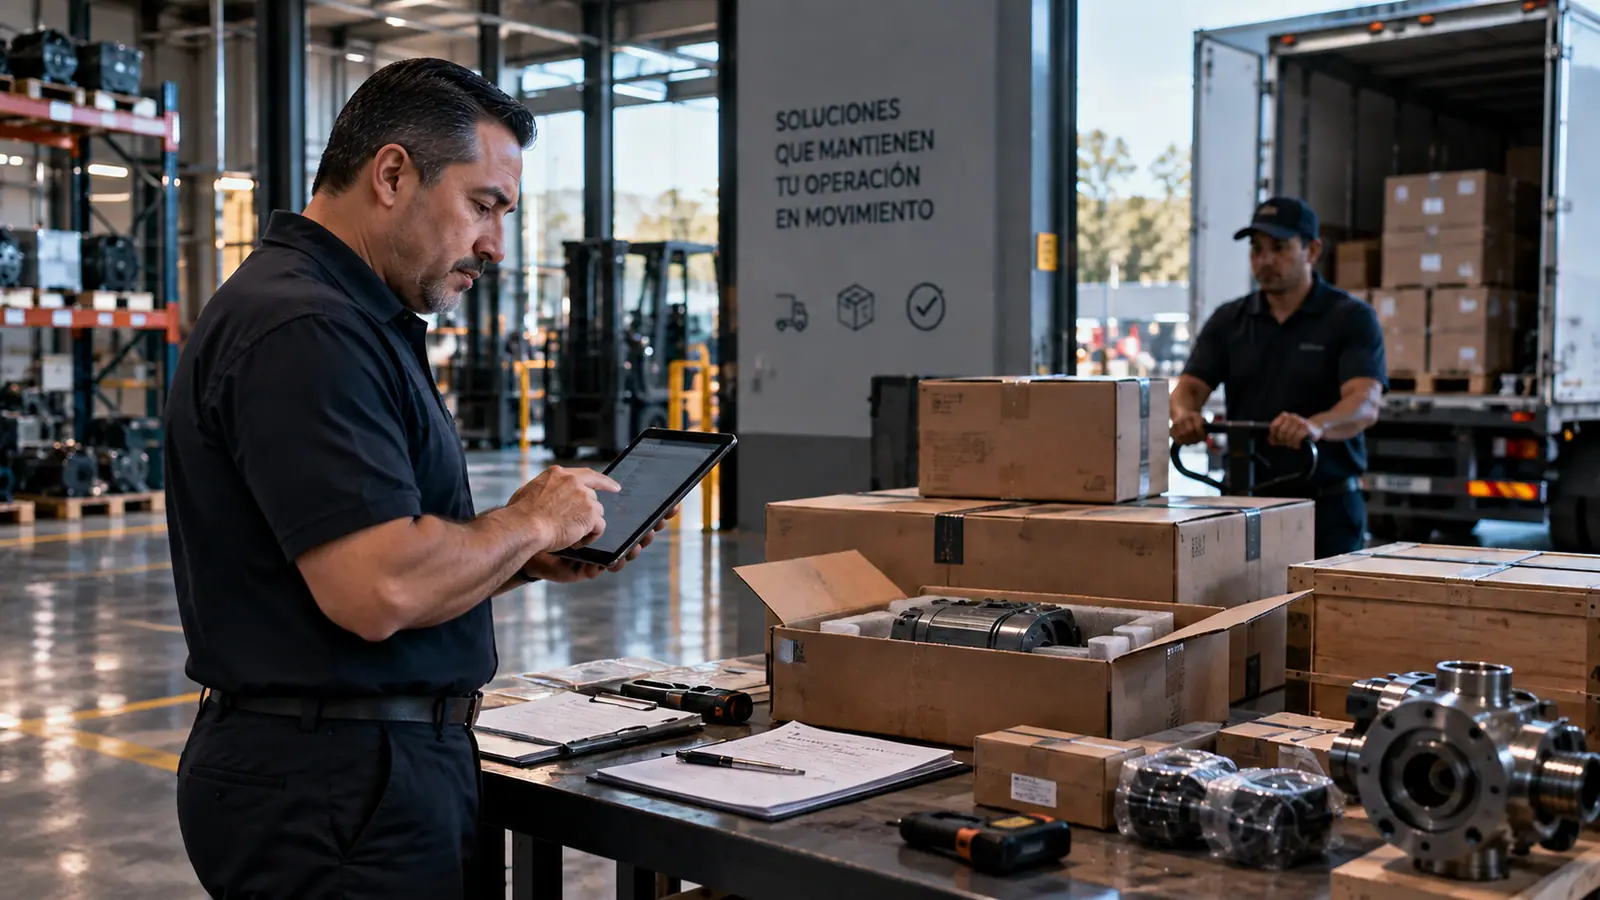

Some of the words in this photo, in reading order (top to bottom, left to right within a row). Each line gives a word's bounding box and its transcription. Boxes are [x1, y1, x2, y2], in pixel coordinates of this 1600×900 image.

[775, 98, 901, 132] SOLUCIONES
[775, 141, 815, 167] QUE
[818, 129, 935, 160] MANTIENEN
[775, 175, 800, 197] TU
[804, 161, 921, 195] OPERACIÓN
[775, 208, 800, 229] EN
[805, 198, 935, 228] MOVIMIENTO
